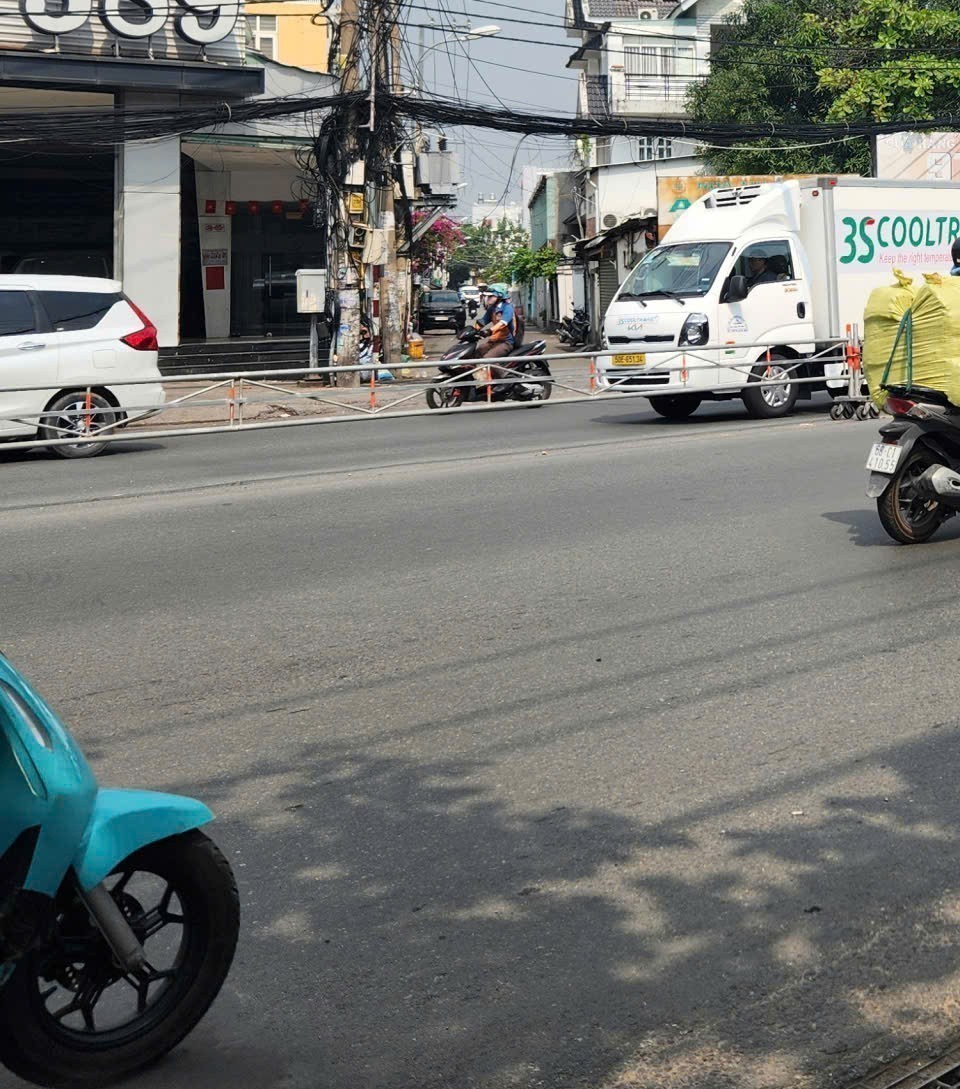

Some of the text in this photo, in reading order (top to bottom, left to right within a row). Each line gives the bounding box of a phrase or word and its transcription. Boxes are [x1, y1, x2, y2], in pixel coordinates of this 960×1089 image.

[879, 252, 896, 264] Keep
[897, 252, 908, 263] the
[908, 252, 923, 265] right
